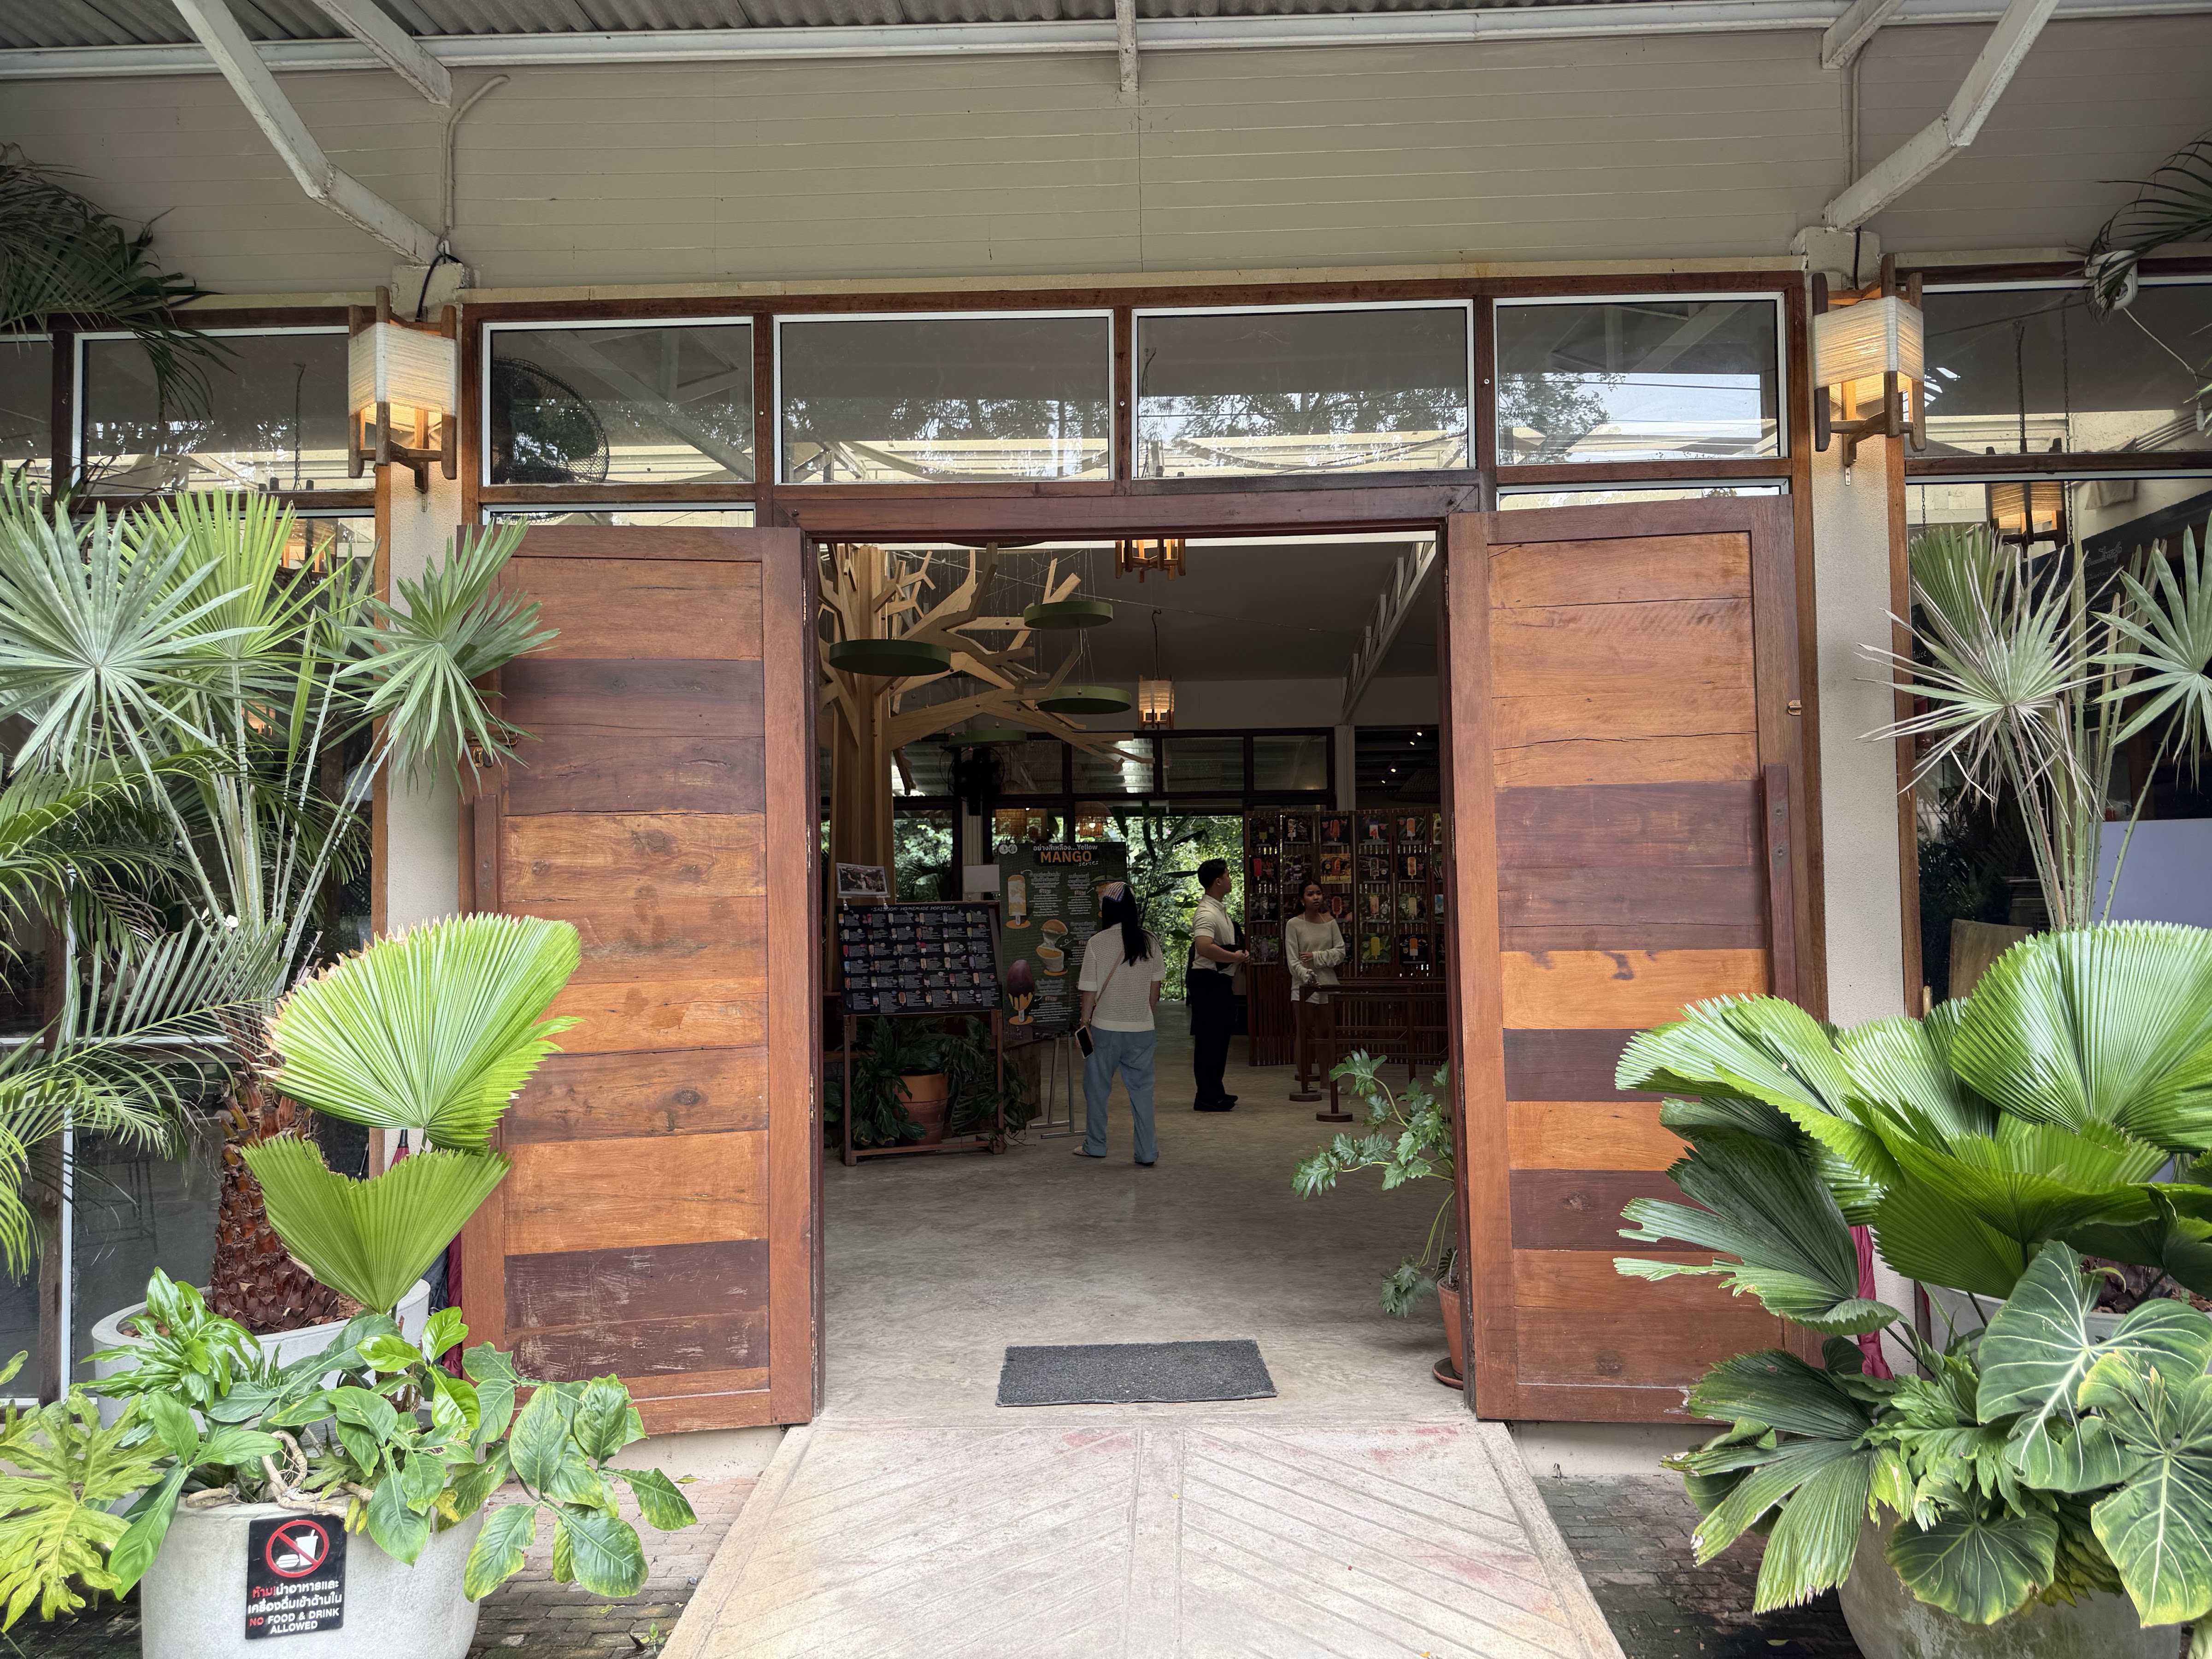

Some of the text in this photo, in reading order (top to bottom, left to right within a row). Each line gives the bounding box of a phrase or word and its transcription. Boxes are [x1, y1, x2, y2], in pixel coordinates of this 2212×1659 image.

[1040, 850, 1092, 863] MANGO
[248, 1591, 342, 1613] เครื่องดื่มเข้าด้านใน
[249, 1608, 340, 1627] NO FOOD & DRINK
[270, 1620, 318, 1634] ALLOWED
